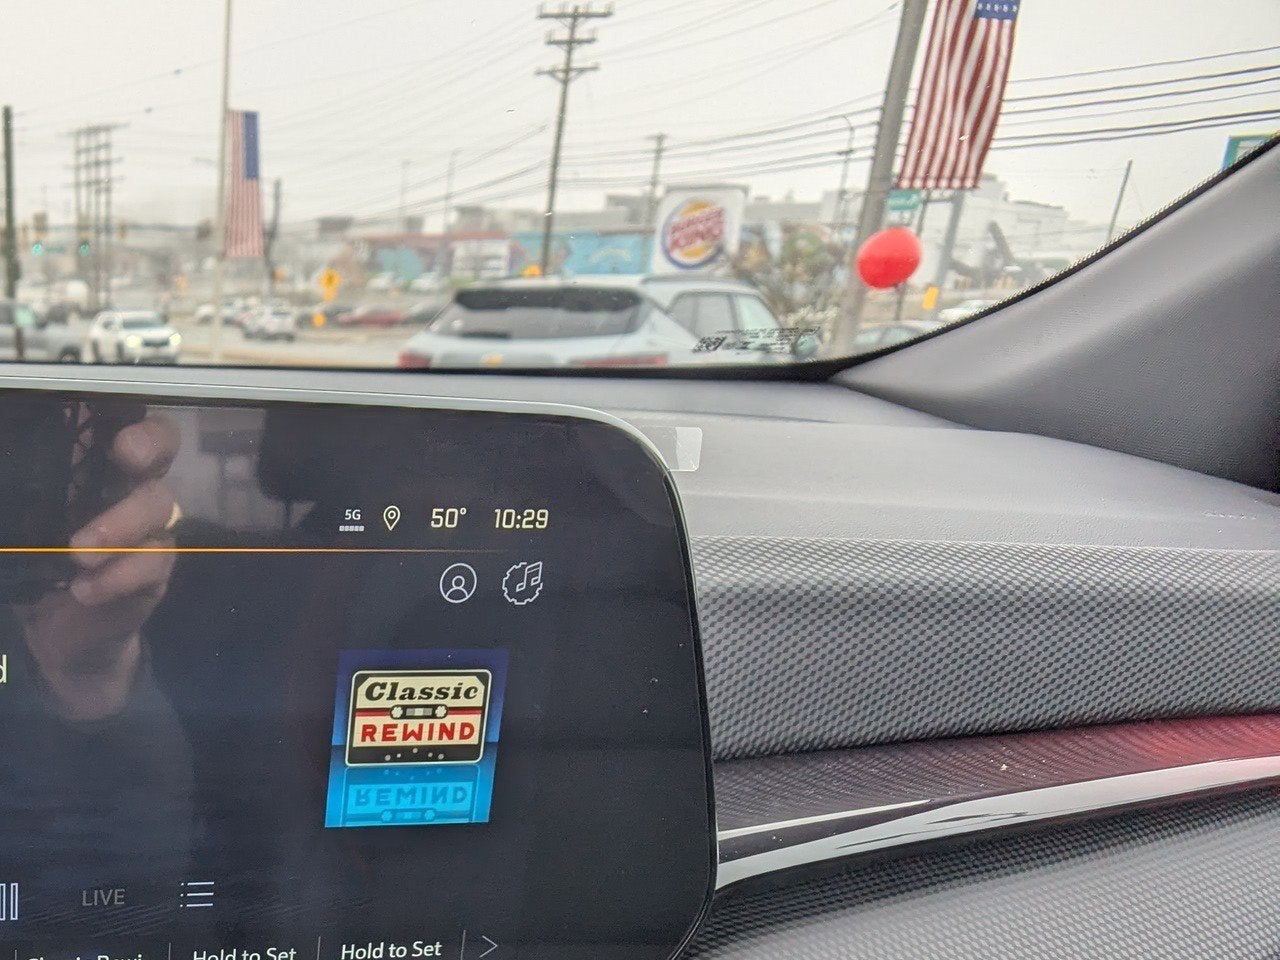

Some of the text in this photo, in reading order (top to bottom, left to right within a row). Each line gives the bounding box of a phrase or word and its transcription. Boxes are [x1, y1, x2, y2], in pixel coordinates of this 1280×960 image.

[344, 509, 361, 521] 5G
[430, 507, 468, 529] 50°
[493, 508, 550, 530] 10:29
[364, 680, 480, 702] Classic
[360, 722, 477, 743] REWIND
[81, 888, 126, 908] LIVE
[341, 940, 442, 960] Hold to Set
